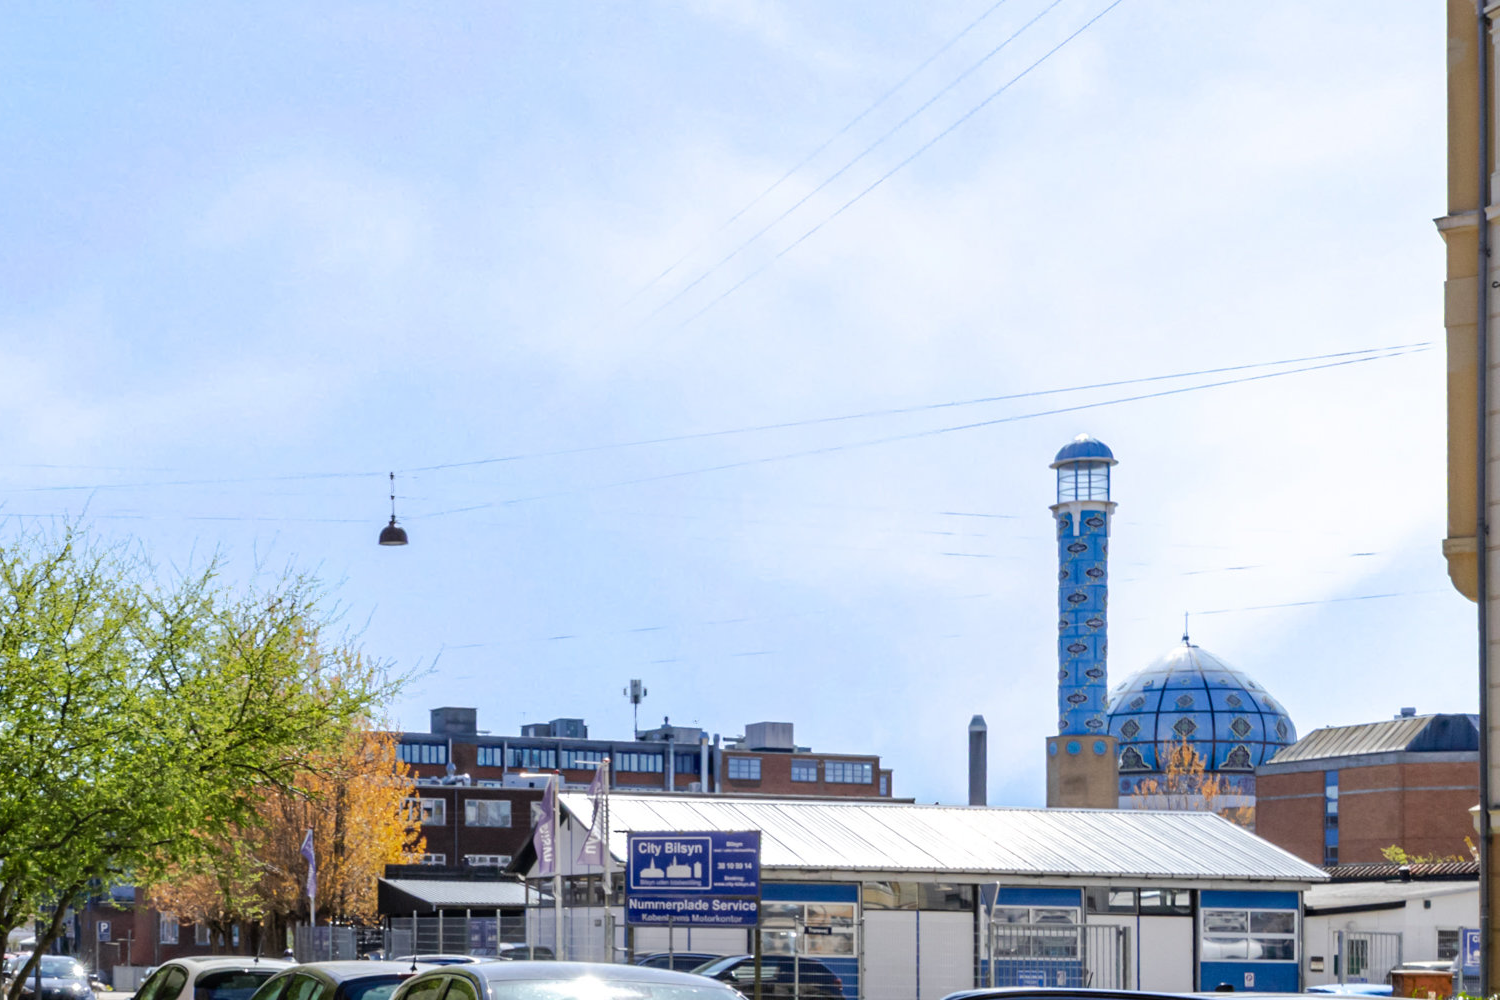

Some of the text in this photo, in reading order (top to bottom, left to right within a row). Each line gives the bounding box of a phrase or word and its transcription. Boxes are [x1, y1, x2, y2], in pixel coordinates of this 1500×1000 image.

[638, 842, 703, 856] City Bilsyn
[629, 898, 757, 912] Nummerplade Service
[691, 914, 742, 922] Motorkontor
